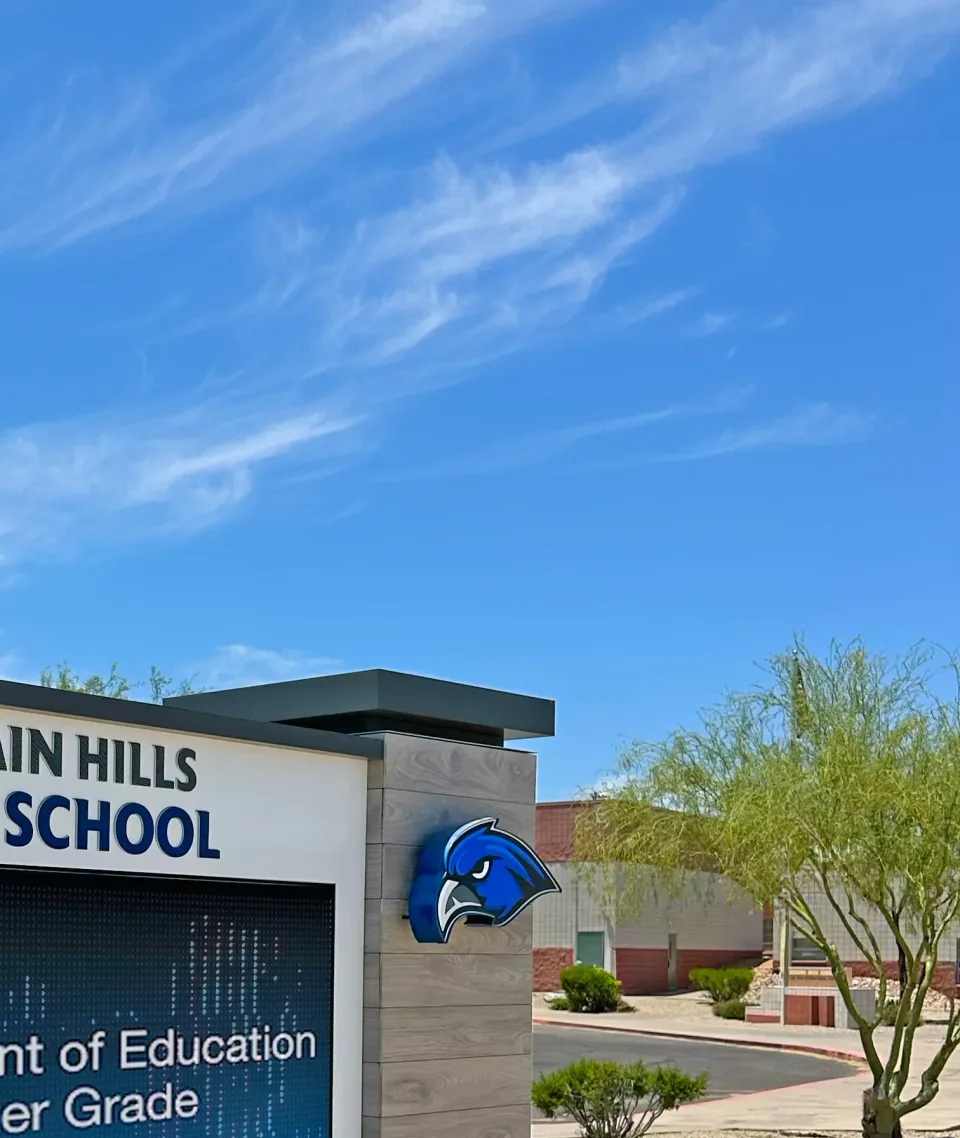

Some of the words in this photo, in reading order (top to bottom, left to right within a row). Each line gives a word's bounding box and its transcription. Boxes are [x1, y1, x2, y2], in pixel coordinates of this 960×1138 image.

[76, 734, 198, 792] HILLS
[4, 791, 221, 859] SCHOOL
[58, 1030, 106, 1073] of
[119, 1025, 317, 1070] Education
[64, 1082, 200, 1128] Grade
